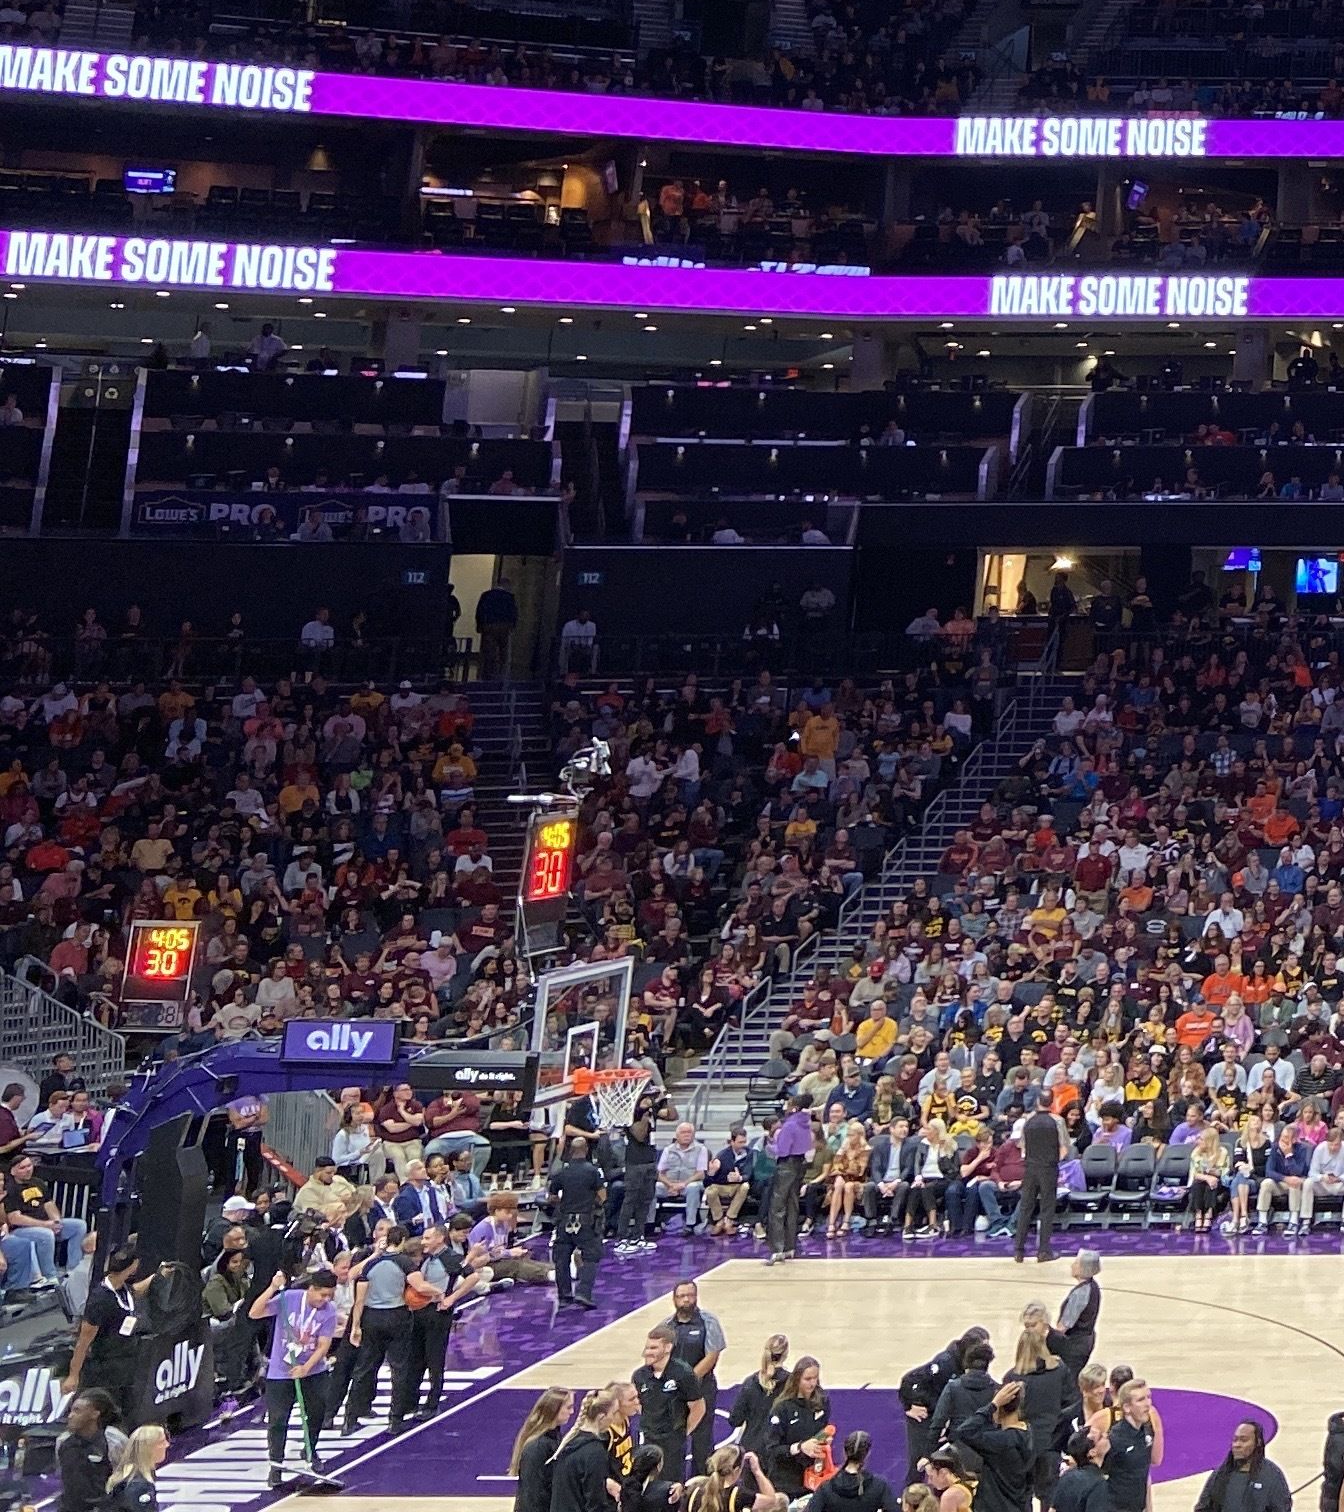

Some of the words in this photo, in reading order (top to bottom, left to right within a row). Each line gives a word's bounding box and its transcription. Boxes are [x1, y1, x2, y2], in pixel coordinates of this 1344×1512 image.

[0, 44, 98, 94] MAKE
[103, 54, 205, 104] SOME
[212, 62, 314, 112] NOISE
[955, 117, 1037, 155] MAKE
[1042, 118, 1122, 156] SOME
[1126, 118, 1207, 157] NOISE
[6, 232, 114, 281] MAKE
[121, 239, 225, 287] SOME
[232, 244, 337, 292] NOISE
[990, 276, 1073, 316] MAKE
[1078, 276, 1160, 317] SOME
[1166, 277, 1249, 317] NOISE
[145, 506, 200, 521] LOWE'S
[209, 502, 277, 526] PRO
[407, 572, 425, 585] 112
[582, 572, 601, 585] 112
[533, 850, 563, 896] 30
[144, 949, 177, 976] 30
[306, 1023, 373, 1058] ally
[455, 1067, 478, 1083] ally
[156, 1339, 205, 1390] ally
